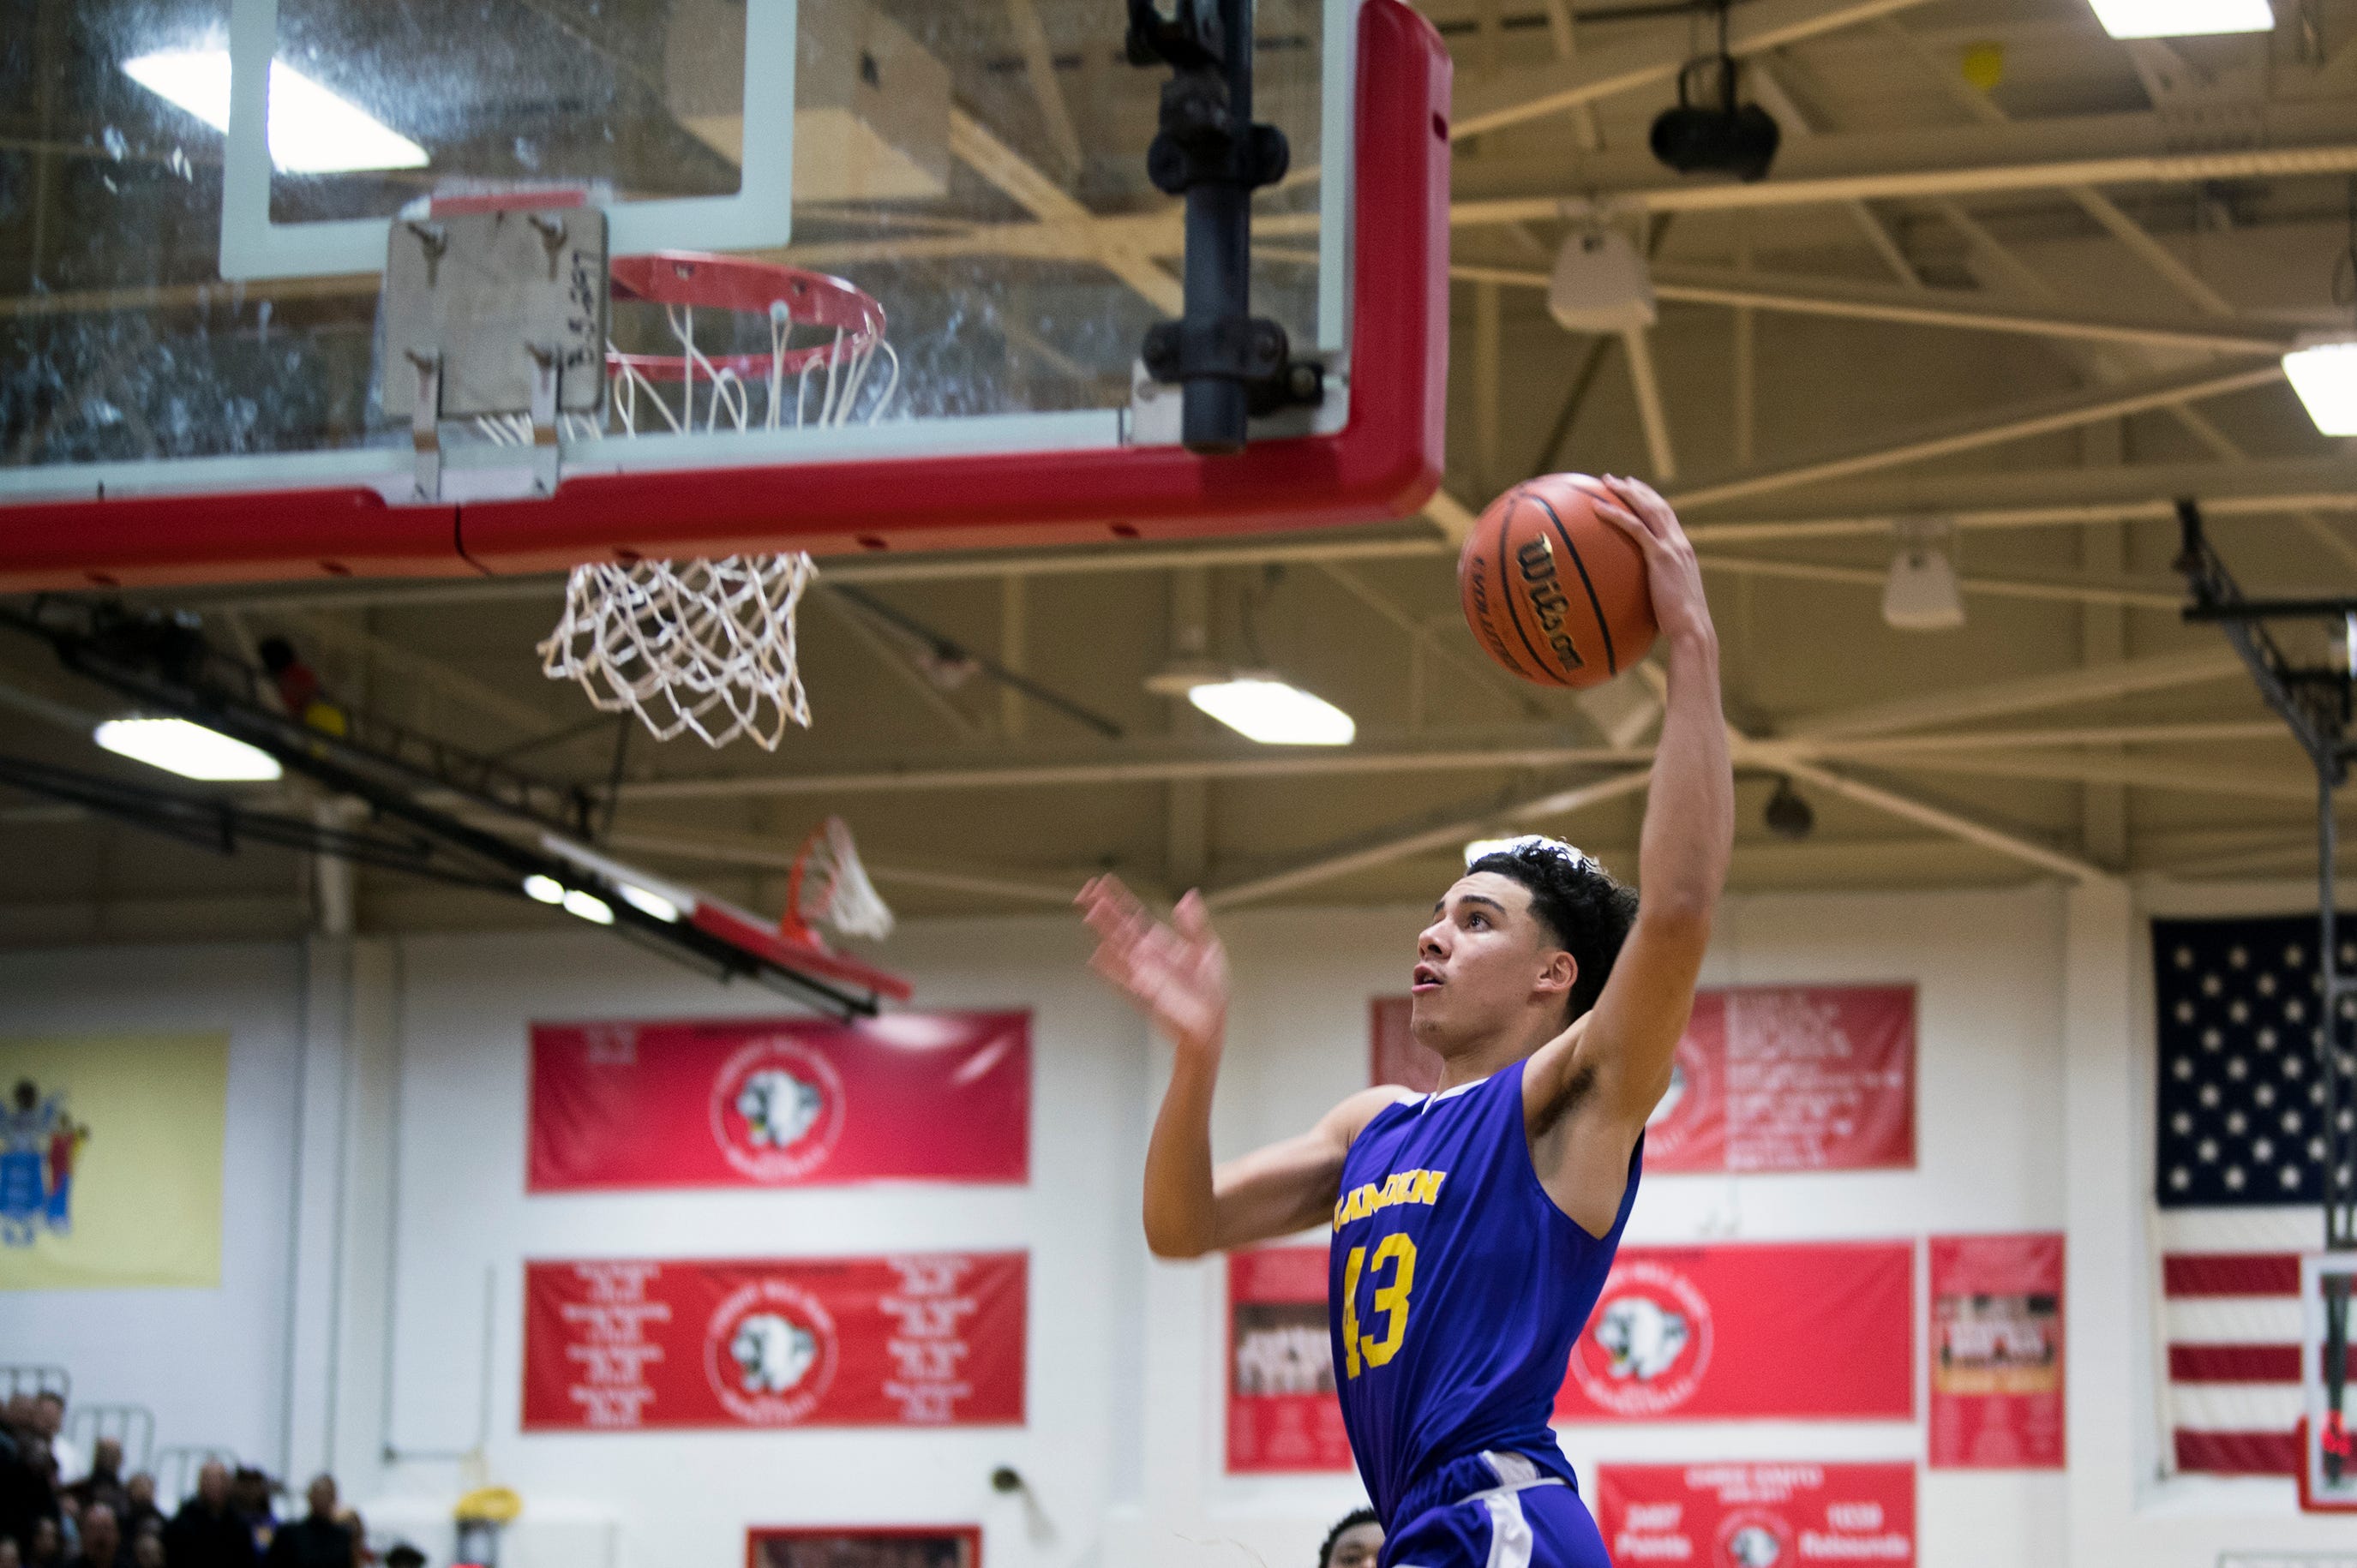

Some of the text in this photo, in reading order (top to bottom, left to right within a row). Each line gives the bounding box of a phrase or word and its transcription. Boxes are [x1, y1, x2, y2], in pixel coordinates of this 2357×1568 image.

[1472, 554, 1532, 678] EVOLUT
[1516, 530, 1585, 674] Wilson
[1342, 1232, 1417, 1380] 43
